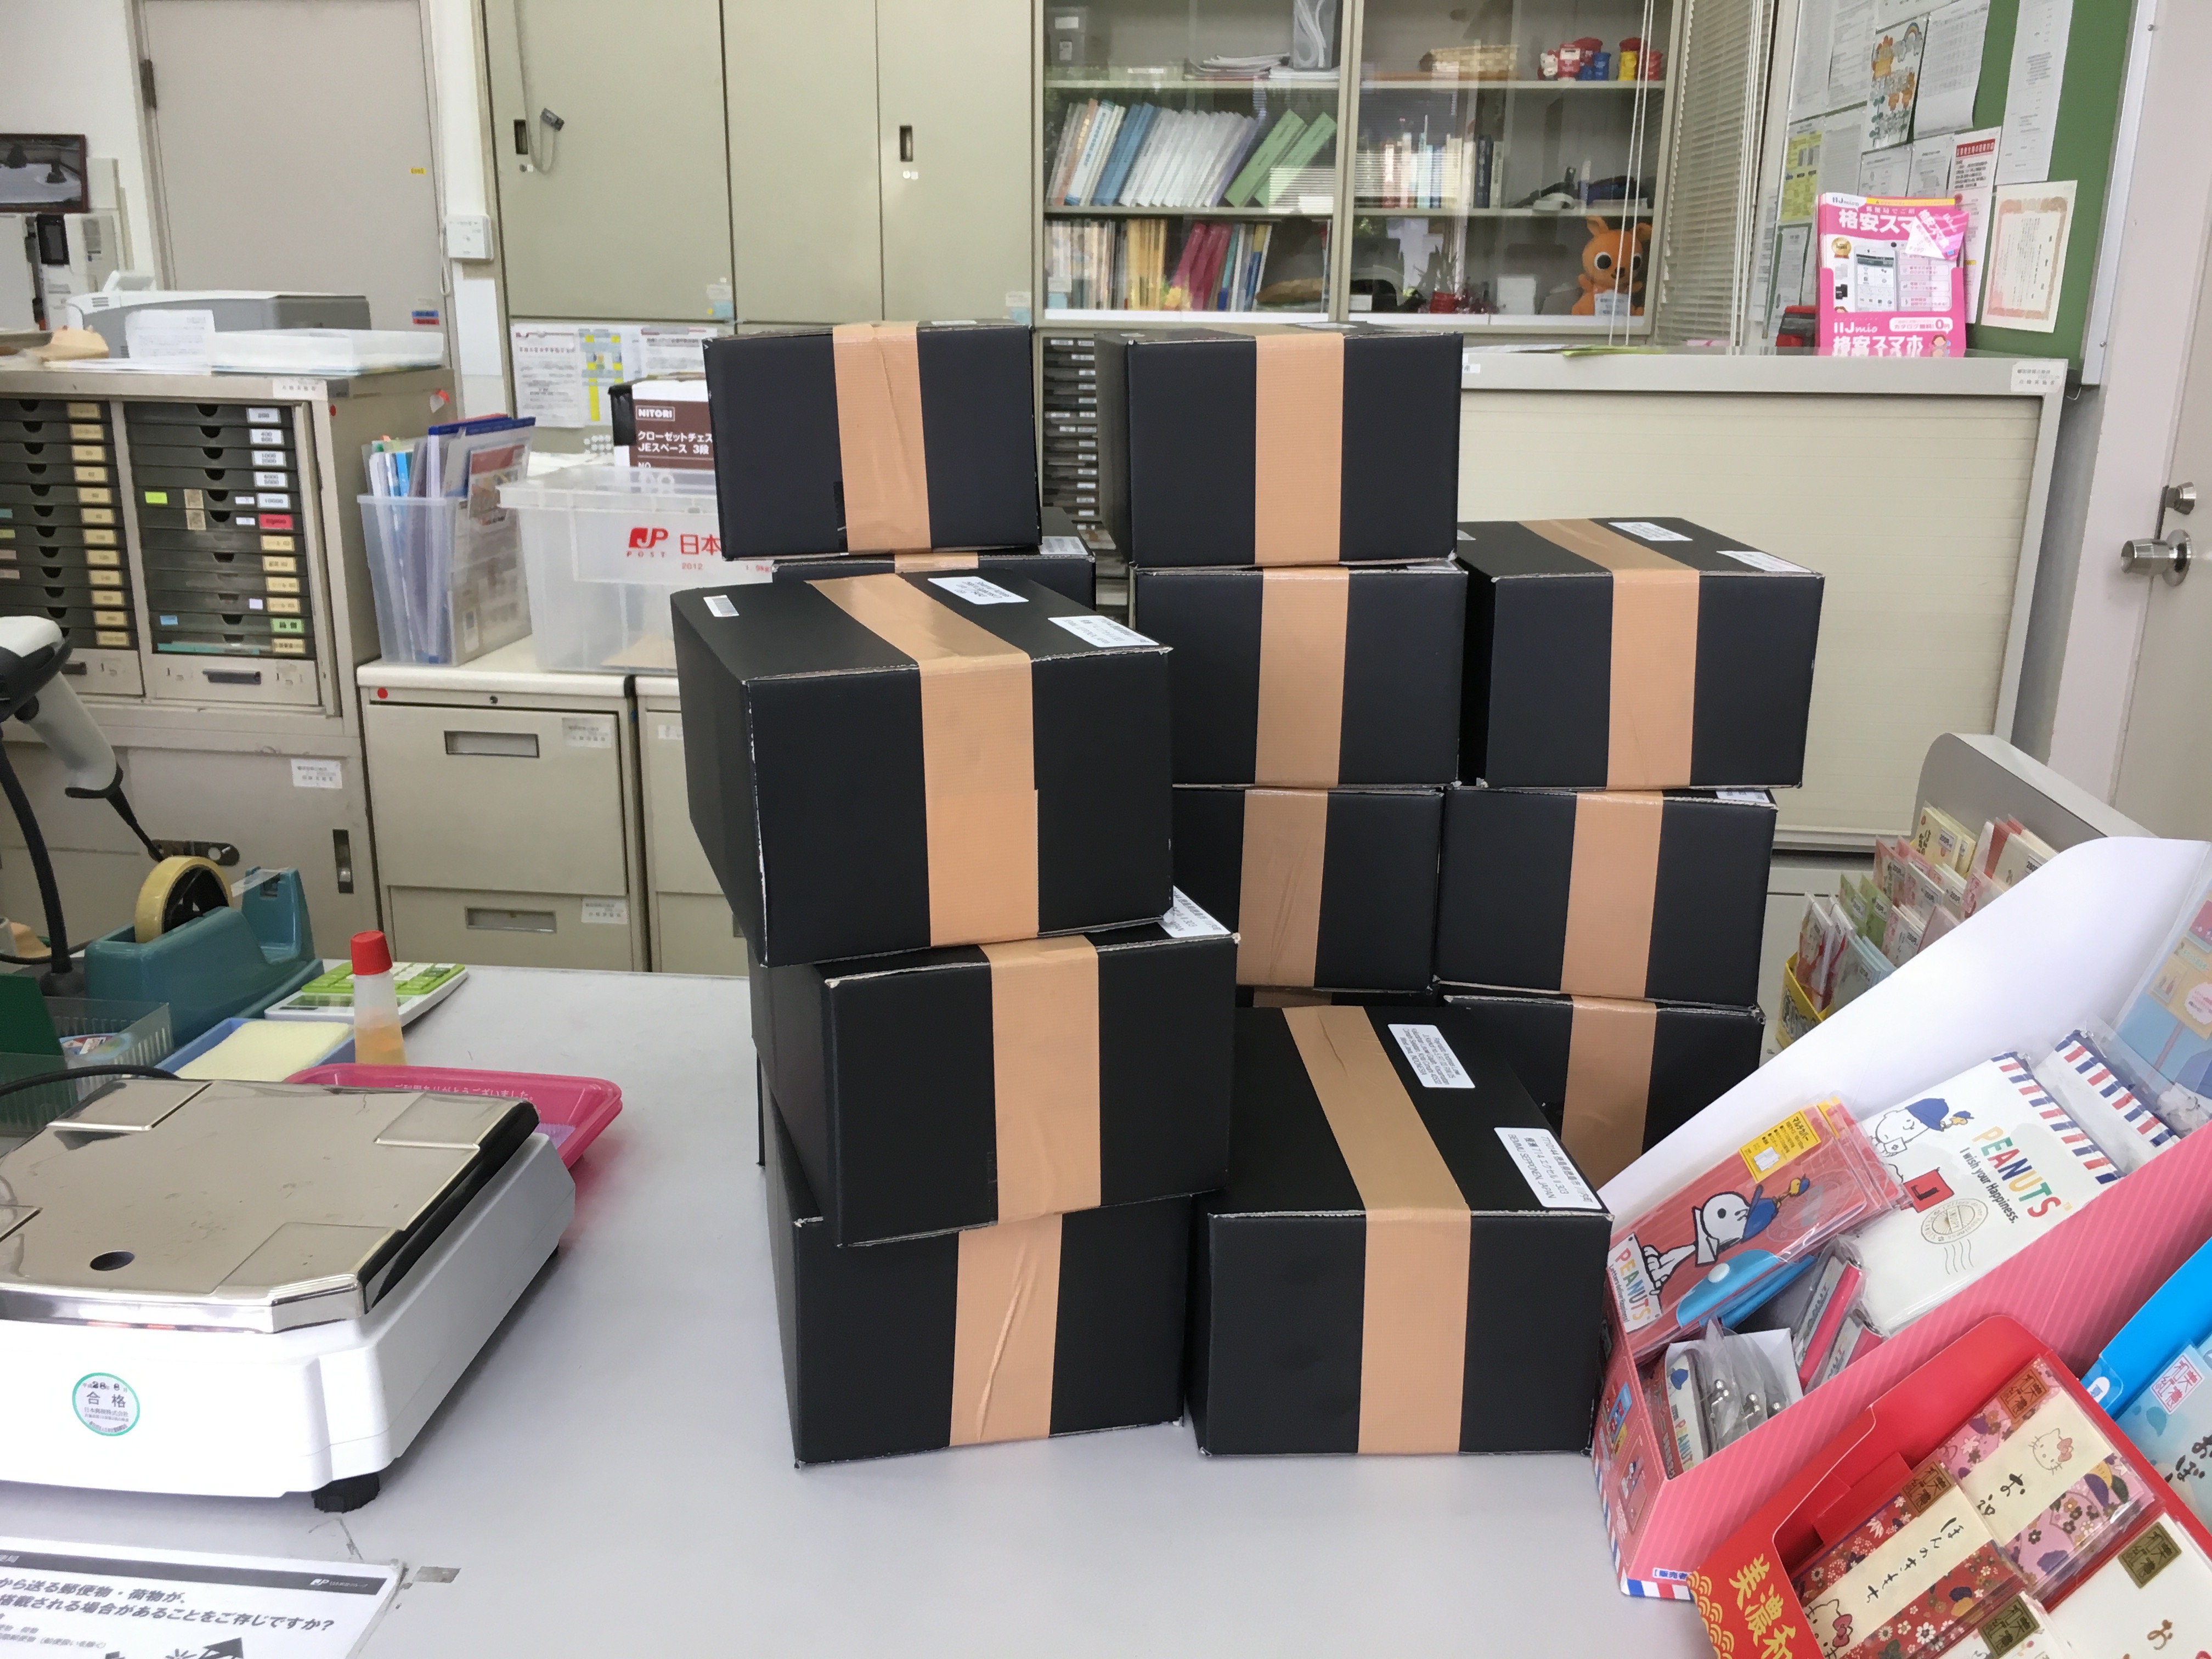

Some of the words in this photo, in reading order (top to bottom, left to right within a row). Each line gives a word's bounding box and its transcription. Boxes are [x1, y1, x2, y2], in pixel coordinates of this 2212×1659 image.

[638, 409, 673, 418] NITORI
[1409, 1055, 1427, 1075] INDONESIA
[1962, 1153, 1981, 1169] wish
[1971, 1167, 1991, 1184] your
[1972, 1126, 2061, 1217] PEANUTS
[1537, 1181, 1556, 1198] JAPAN
[1615, 1248, 1651, 1321] PEANUTS
[86, 1391, 126, 1409] 合格
[1866, 1517, 1967, 1605] ほんのきもち
